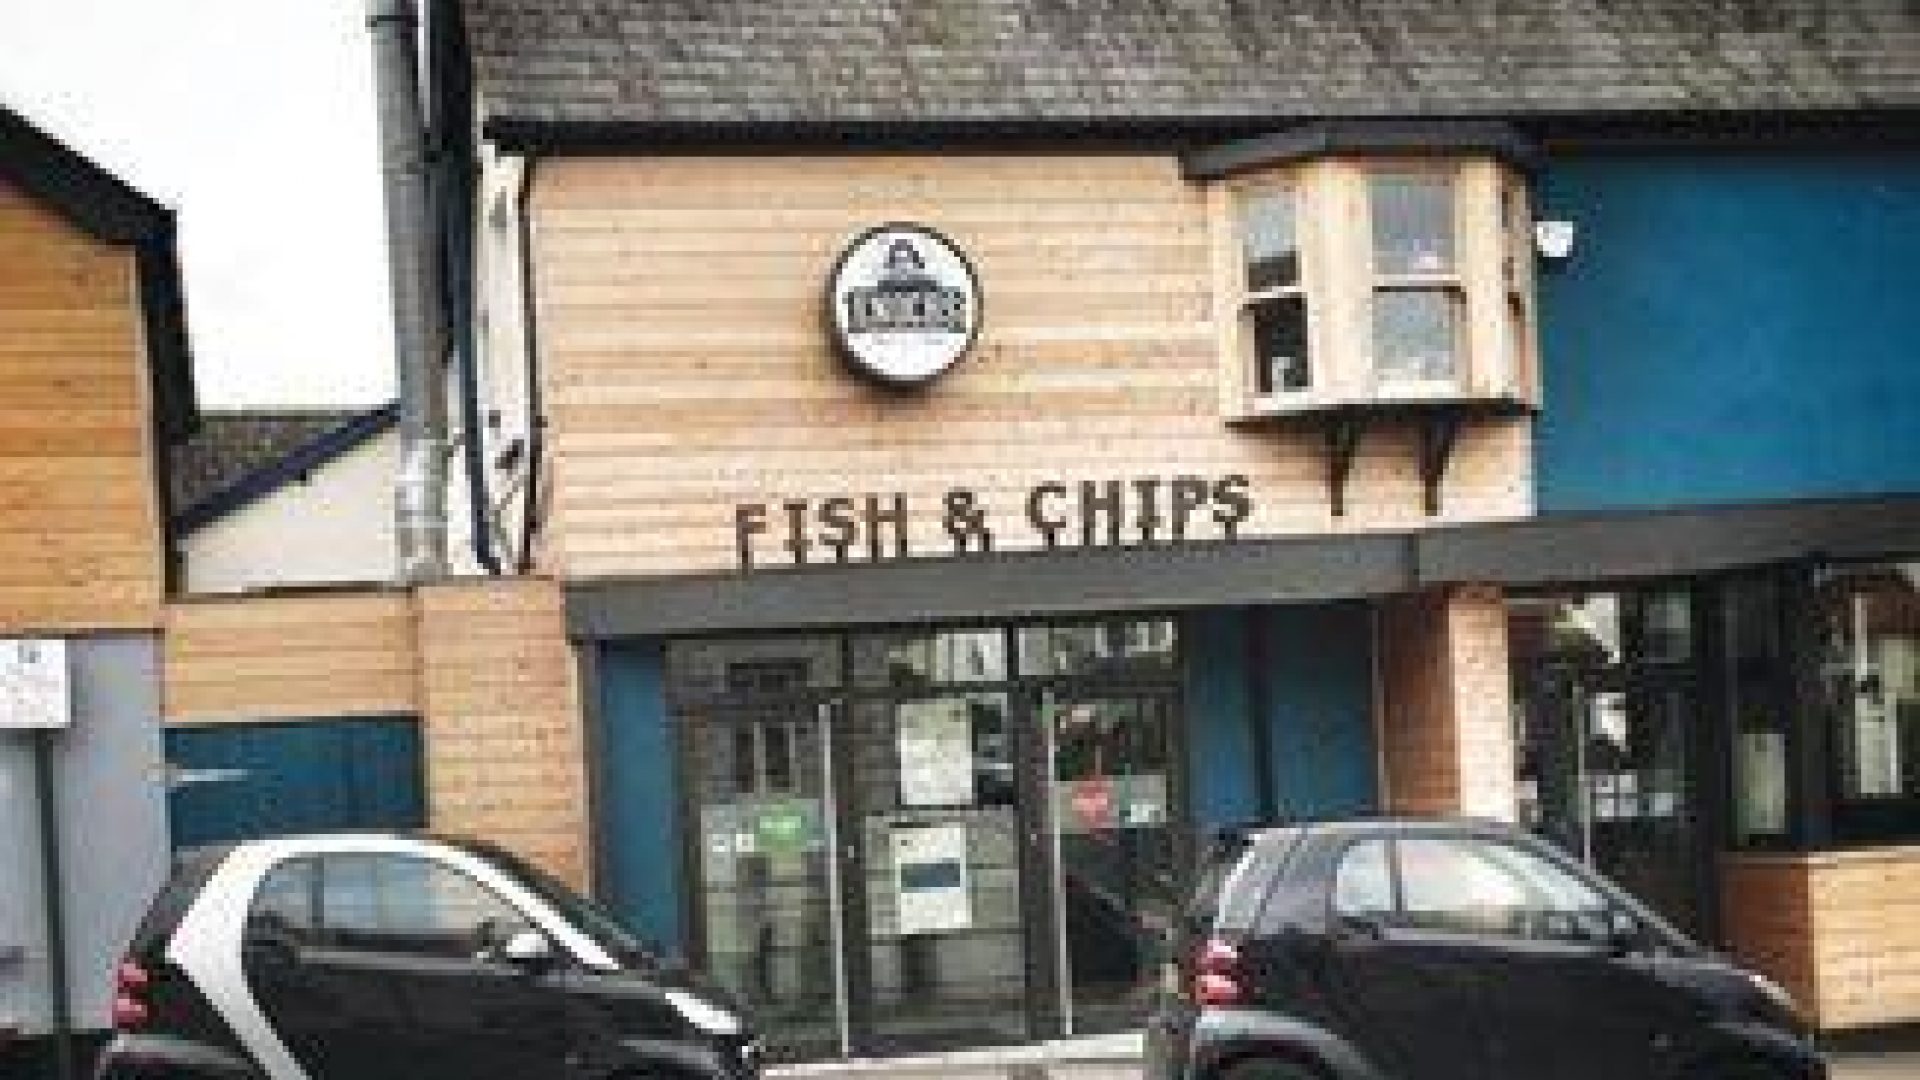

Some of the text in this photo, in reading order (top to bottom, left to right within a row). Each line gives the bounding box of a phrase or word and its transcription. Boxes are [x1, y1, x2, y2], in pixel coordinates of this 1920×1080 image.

[735, 474, 1253, 564] FISH & CHIPS
